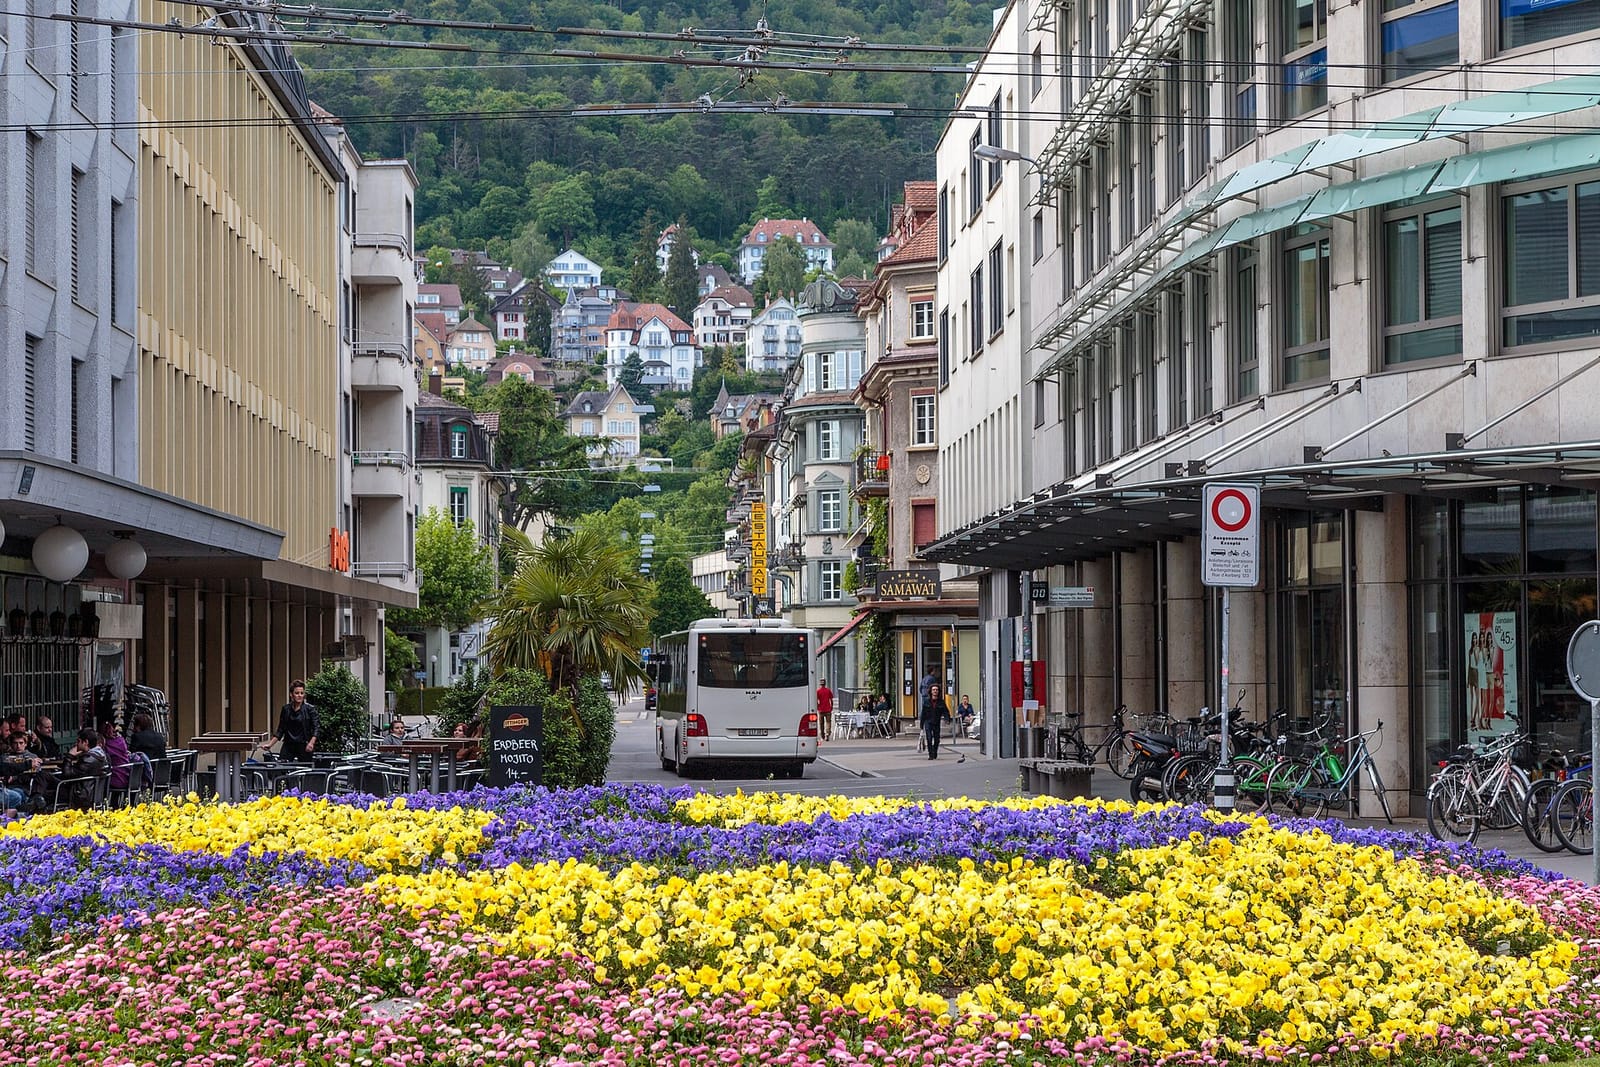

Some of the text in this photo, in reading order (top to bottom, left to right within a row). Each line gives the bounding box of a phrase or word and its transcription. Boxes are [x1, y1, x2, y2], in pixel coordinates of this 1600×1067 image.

[754, 504, 765, 593] RESTAURANT
[880, 583, 937, 596] SAMAWAT
[493, 739, 539, 751] ERDBEER
[500, 753, 534, 764] MOJITO
[505, 767, 528, 779] 14.-
